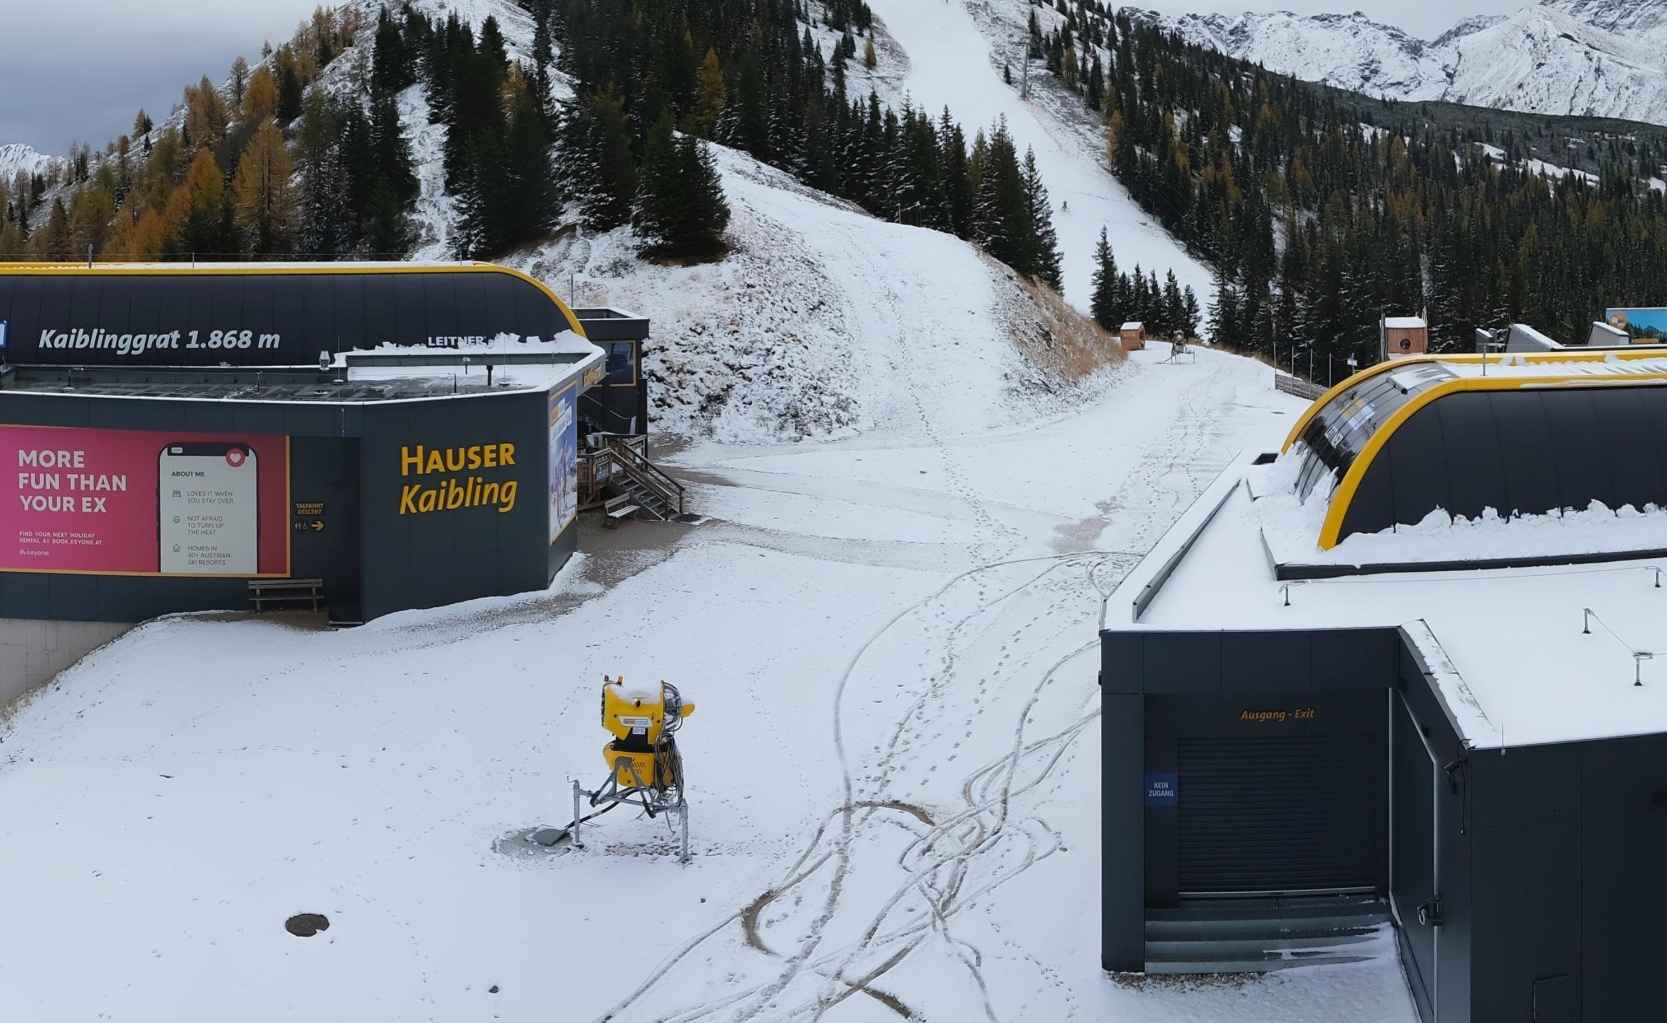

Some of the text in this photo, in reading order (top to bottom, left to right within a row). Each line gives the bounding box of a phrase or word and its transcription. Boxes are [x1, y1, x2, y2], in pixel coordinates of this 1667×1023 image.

[38, 328, 281, 356] Kaiblinggrat 1.868 m
[18, 449, 85, 469] MORE
[401, 443, 516, 476] HAUSER
[18, 472, 127, 492] FUN THAN
[19, 495, 107, 513] YOUR EX
[399, 476, 518, 515] Kaibling
[26, 549, 49, 557] keyone
[1240, 709, 1286, 722] Ausgang
[1294, 708, 1315, 719] Exit
[1148, 789, 1174, 797] ZUGANG
